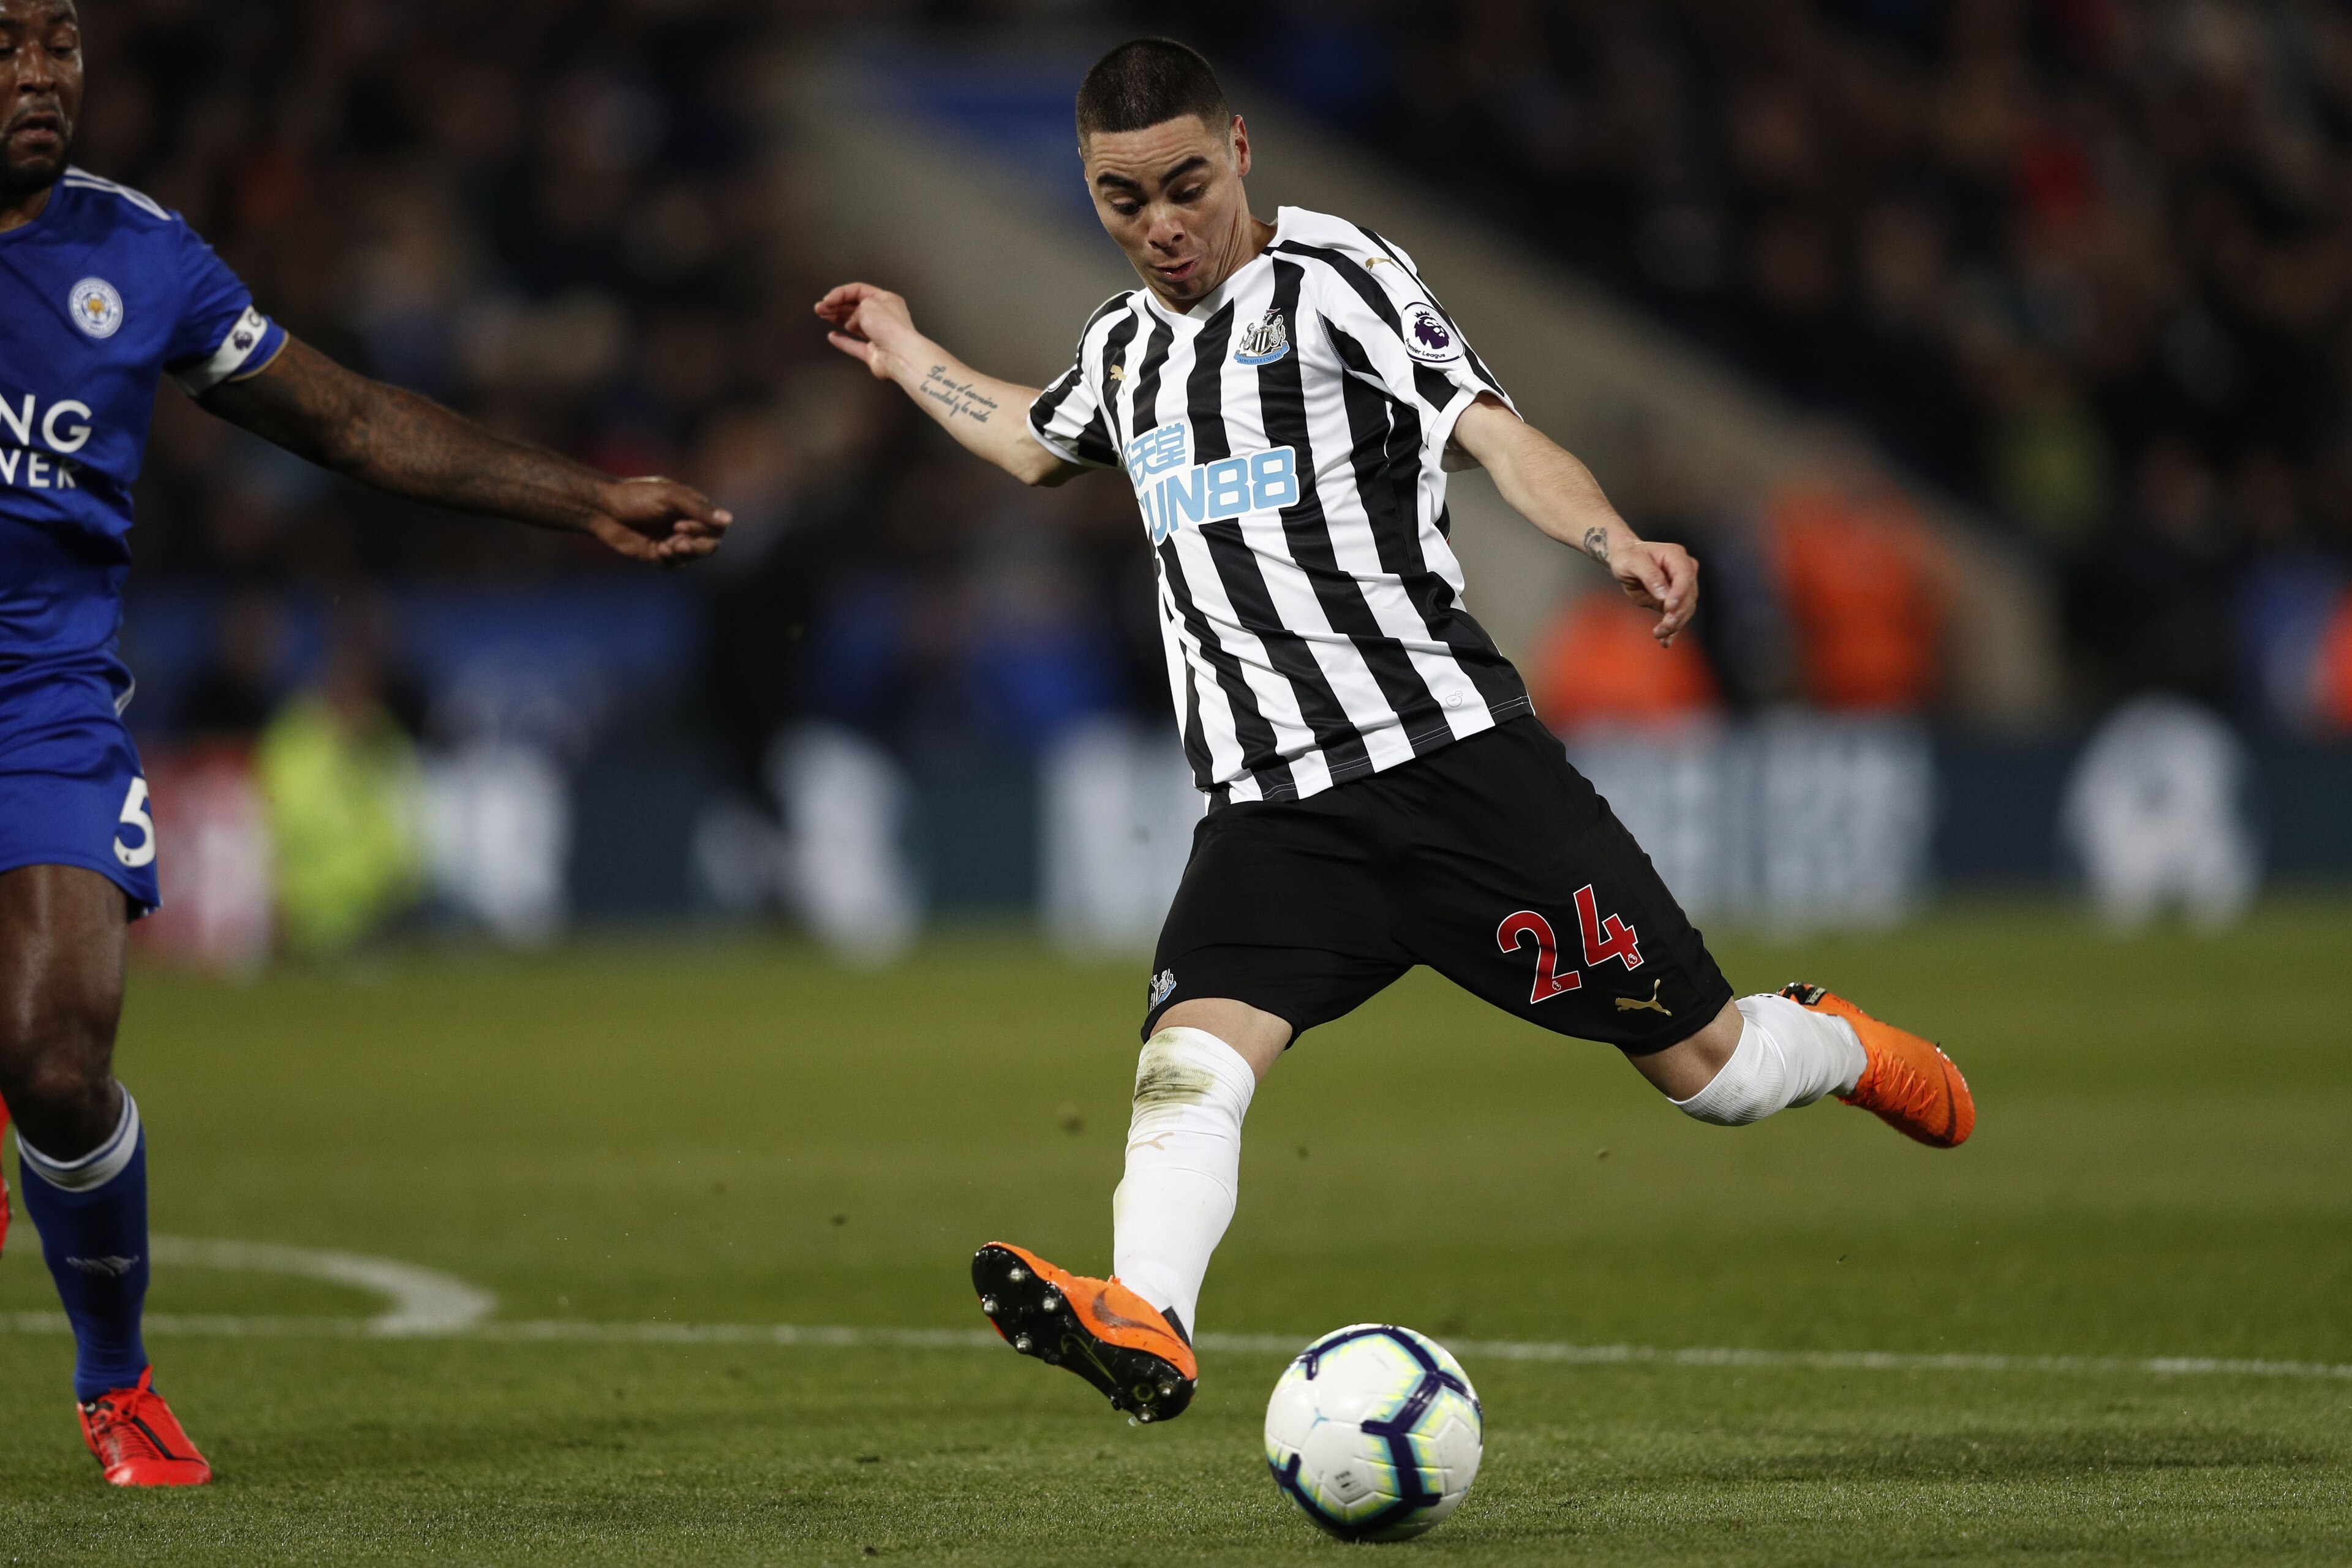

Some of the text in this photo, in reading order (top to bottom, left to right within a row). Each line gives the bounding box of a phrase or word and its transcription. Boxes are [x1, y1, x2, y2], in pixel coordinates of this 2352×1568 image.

[1262, 353, 1281, 362] UNITED
[1405, 337, 1446, 359] Premier League
[1139, 448, 1298, 543] UN88
[113, 775, 156, 867] 5
[1496, 883, 1645, 1005] 24
